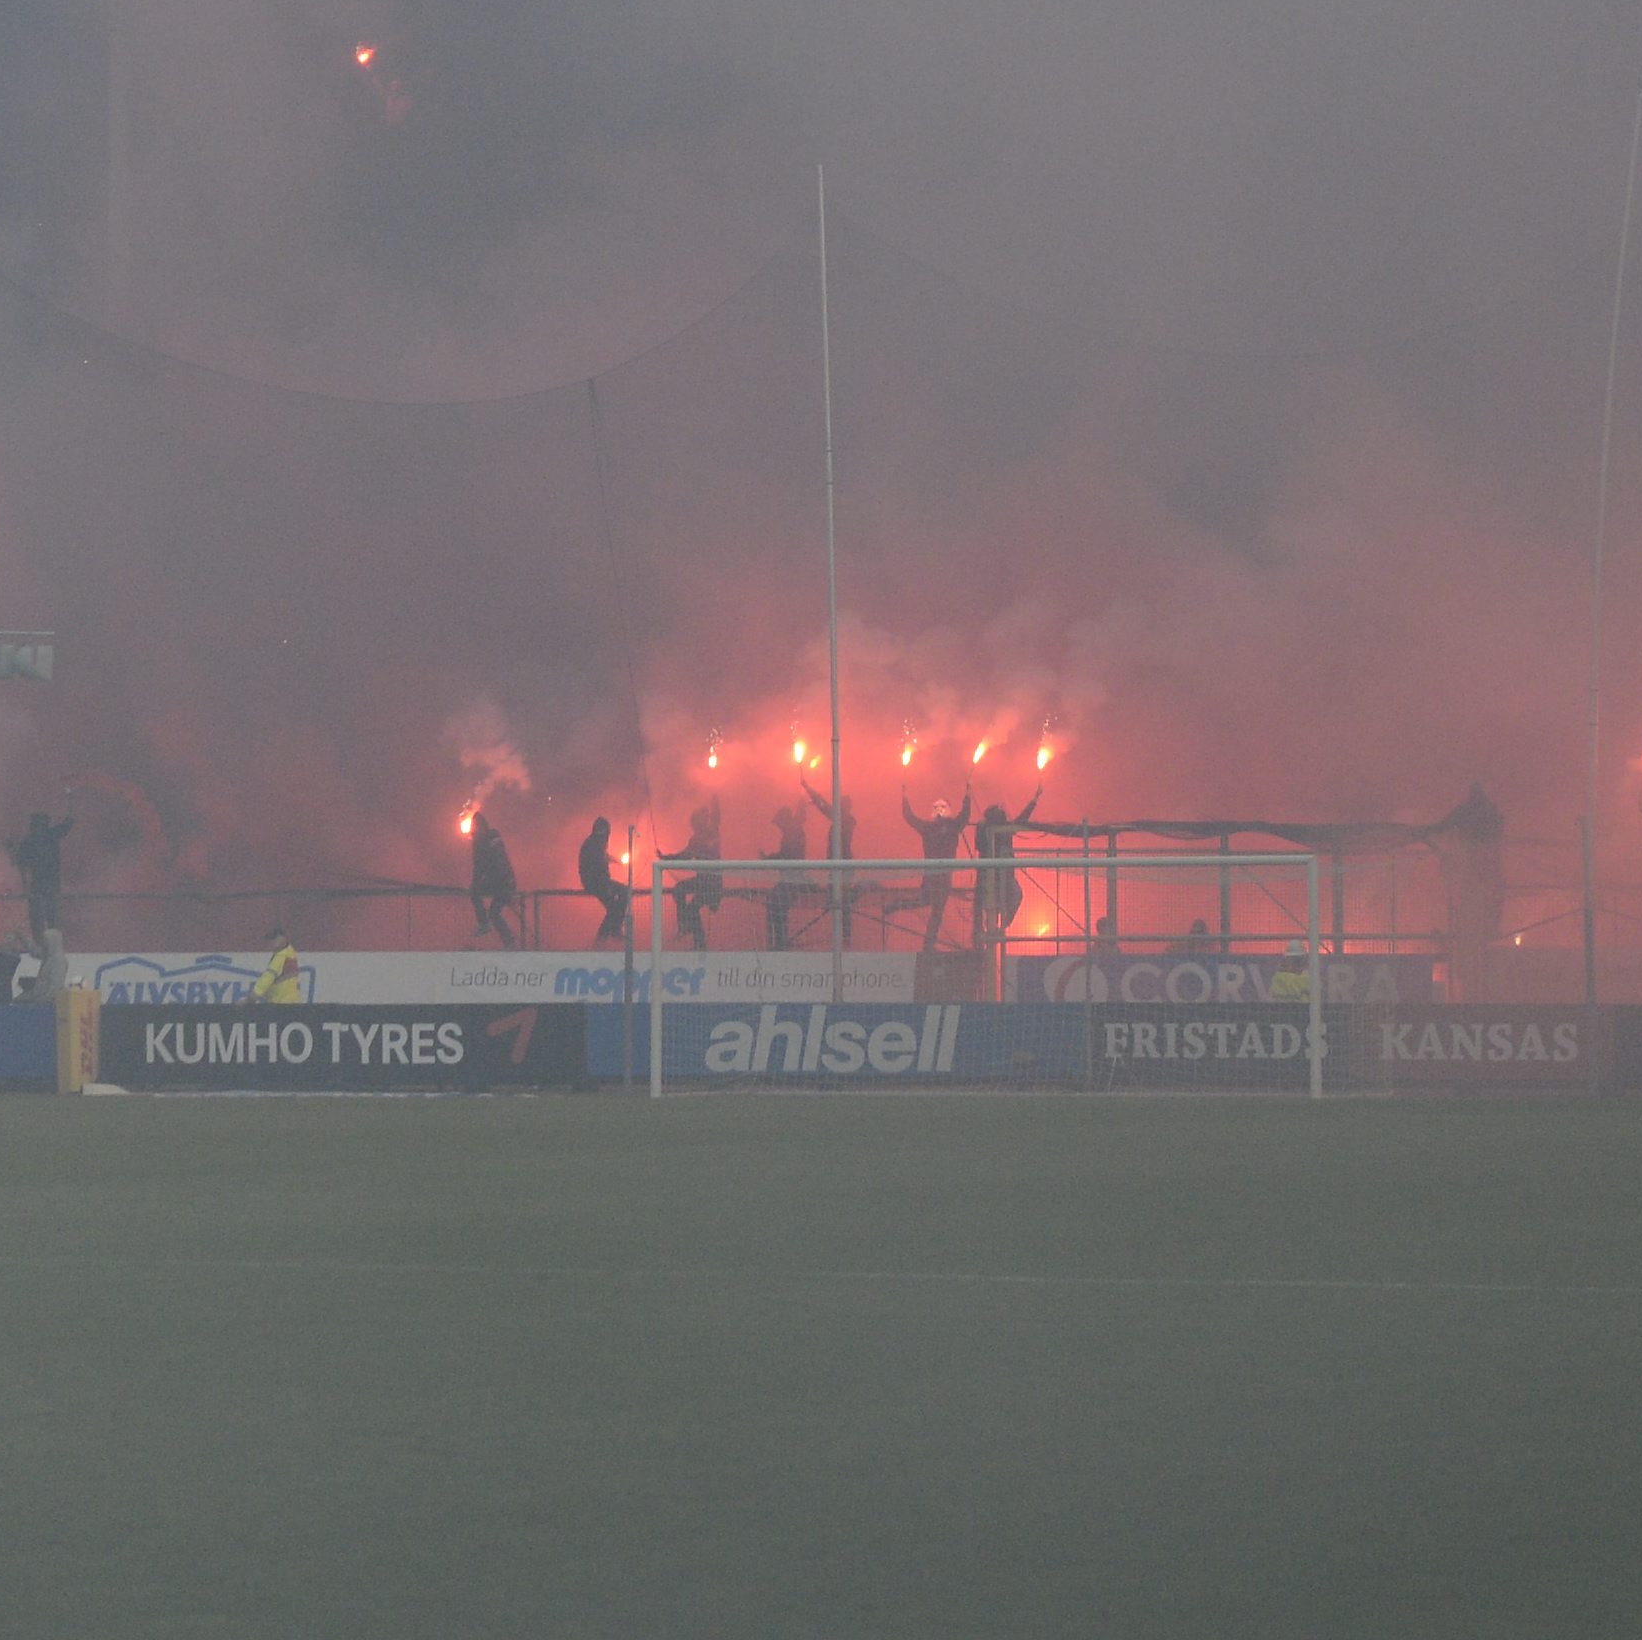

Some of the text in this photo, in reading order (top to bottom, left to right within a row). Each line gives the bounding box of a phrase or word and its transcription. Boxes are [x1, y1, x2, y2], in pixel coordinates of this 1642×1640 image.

[451, 967, 509, 987] Ladda
[514, 971, 548, 987] ner
[717, 968, 739, 988] till
[1121, 962, 1399, 1003] CORVRA
[145, 1021, 464, 1066] KUMHO TYRES
[704, 1004, 960, 1073] ahlsell
[1104, 1022, 1579, 1061] FRISTADS KANSAS
